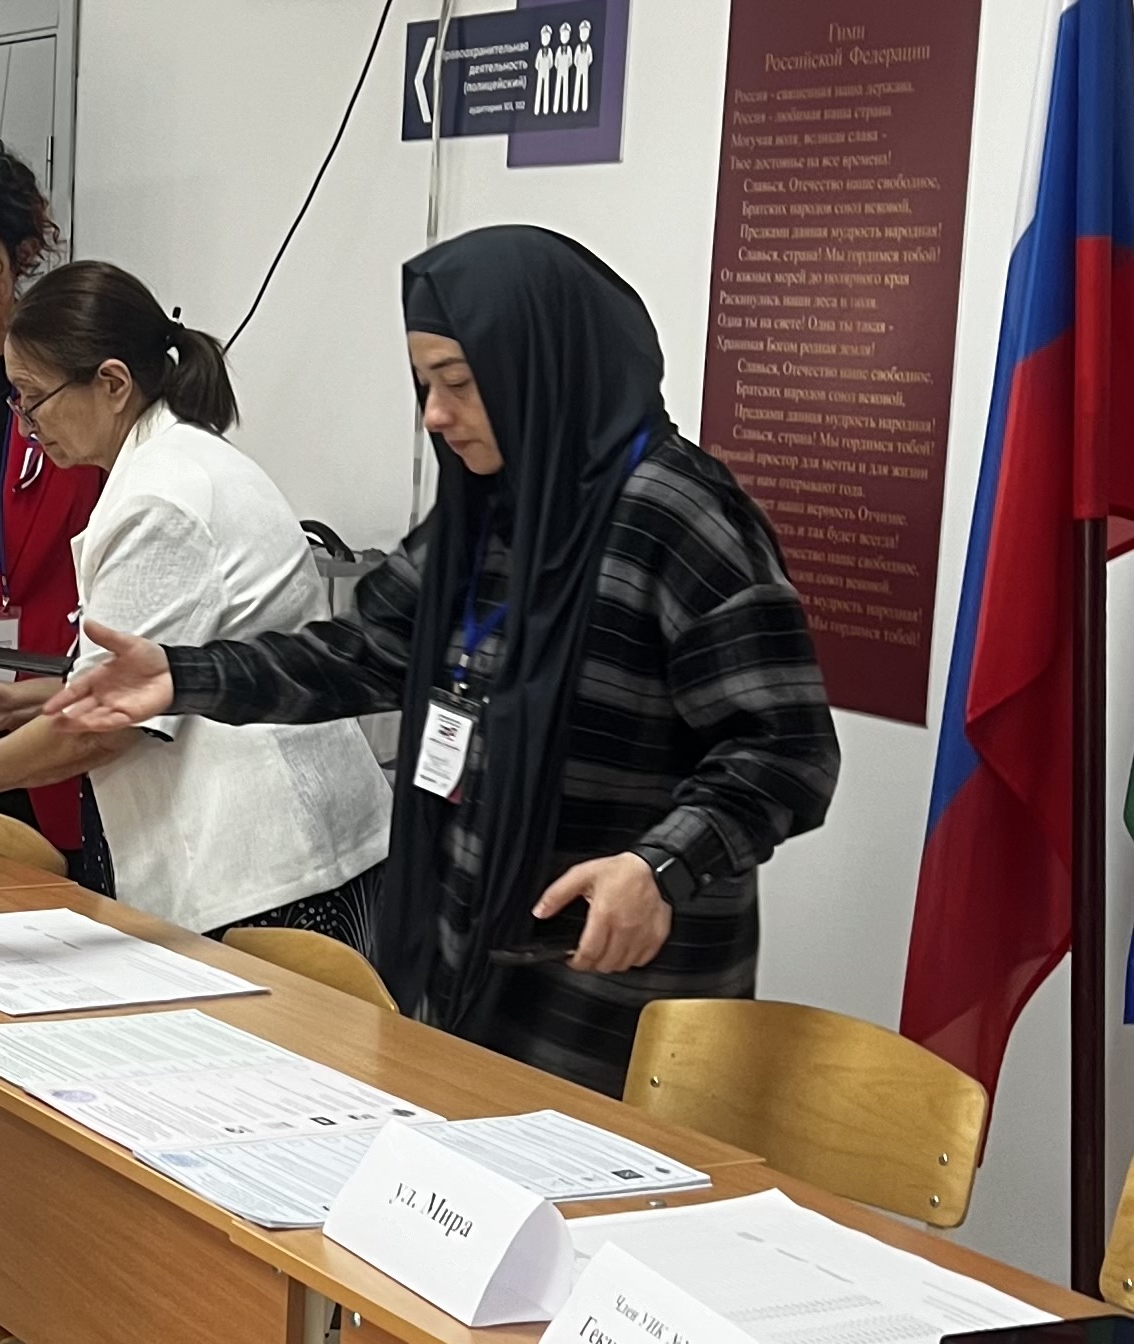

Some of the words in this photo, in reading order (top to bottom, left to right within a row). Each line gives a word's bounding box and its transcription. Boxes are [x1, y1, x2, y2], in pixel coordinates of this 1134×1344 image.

[829, 23, 866, 43] Гимн
[765, 49, 843, 72] Российской
[849, 45, 931, 68] Федерации
[388, 1182, 417, 1209] ул.
[419, 1192, 474, 1238] Мира
[616, 1294, 639, 1323] Член
